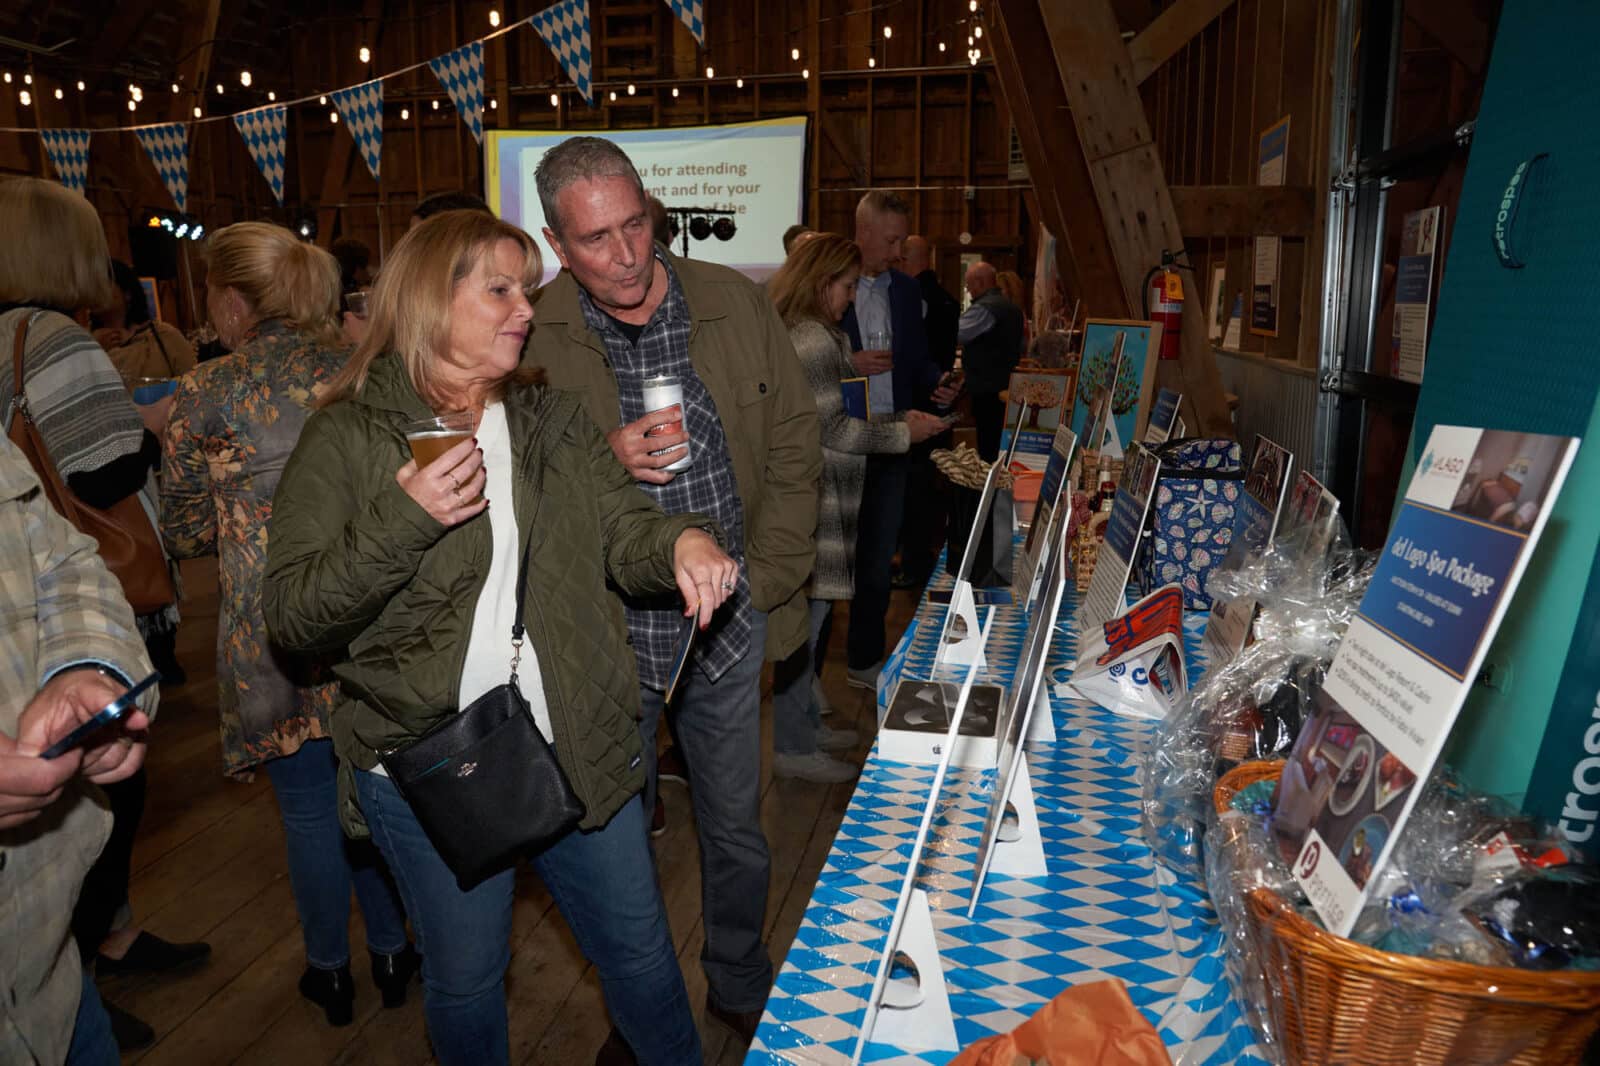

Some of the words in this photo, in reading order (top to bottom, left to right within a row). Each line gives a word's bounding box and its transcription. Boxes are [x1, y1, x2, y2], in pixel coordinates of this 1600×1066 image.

[652, 164, 673, 177] for
[676, 162, 747, 177] attending
[671, 184, 699, 197] and
[702, 182, 725, 196] for
[727, 183, 761, 198] your
[1404, 541, 1428, 569] Lago
[1426, 549, 1448, 577] Spa
[1445, 557, 1496, 598] Package
